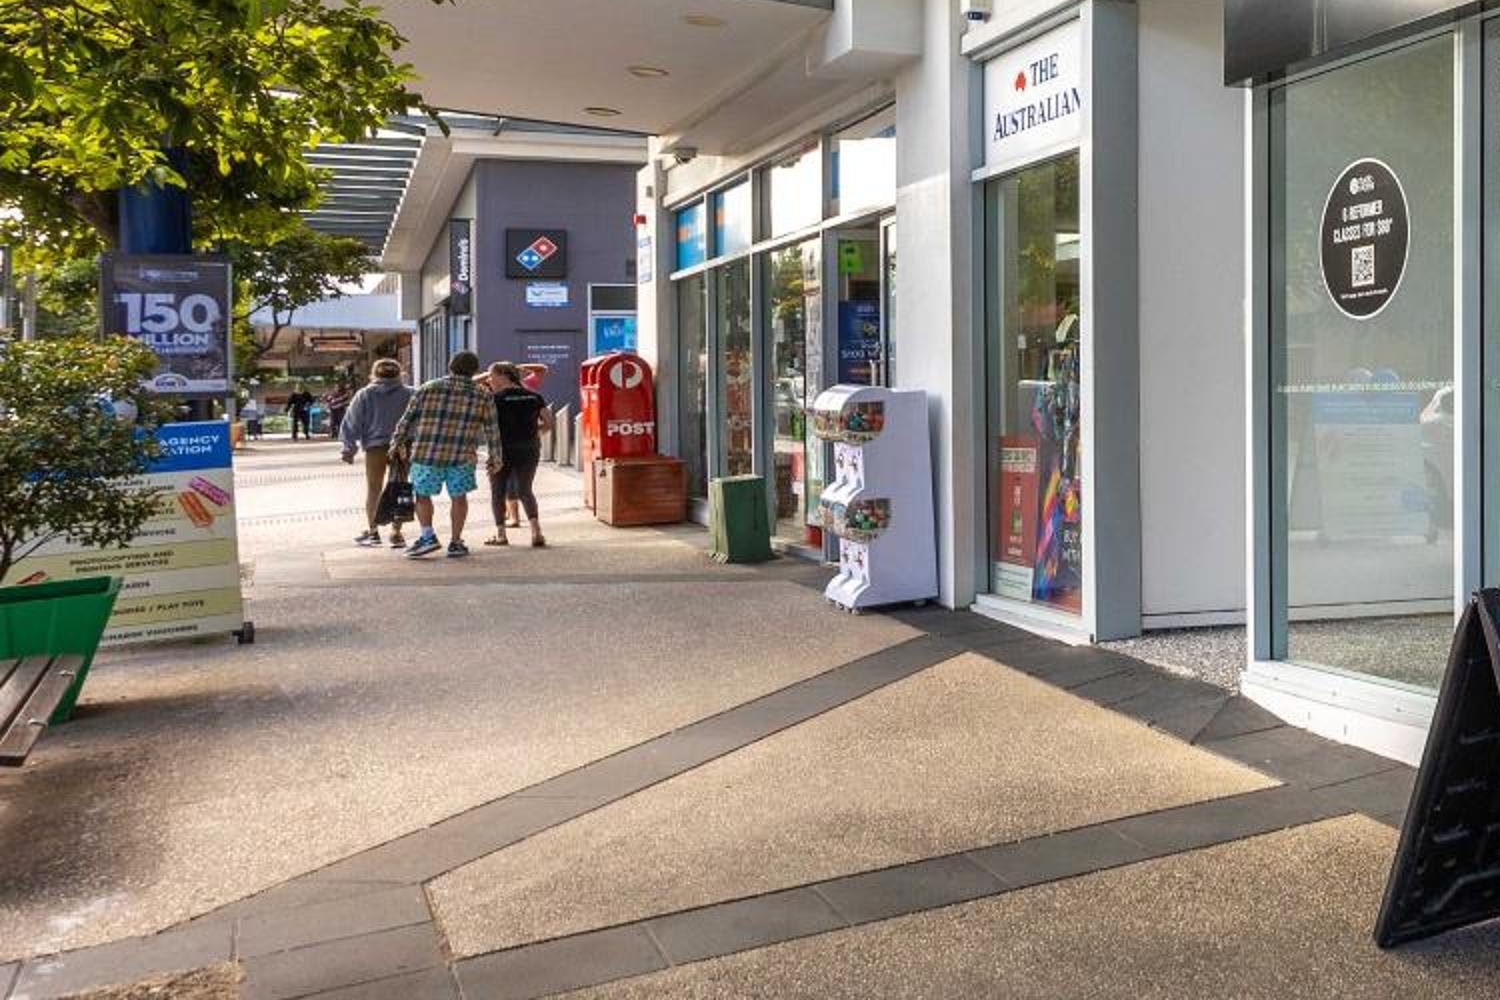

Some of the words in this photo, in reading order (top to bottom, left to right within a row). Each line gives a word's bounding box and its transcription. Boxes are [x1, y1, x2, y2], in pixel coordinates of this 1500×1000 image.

[1029, 53, 1059, 87] THE
[114, 292, 221, 333] 150
[607, 422, 655, 437] POST
